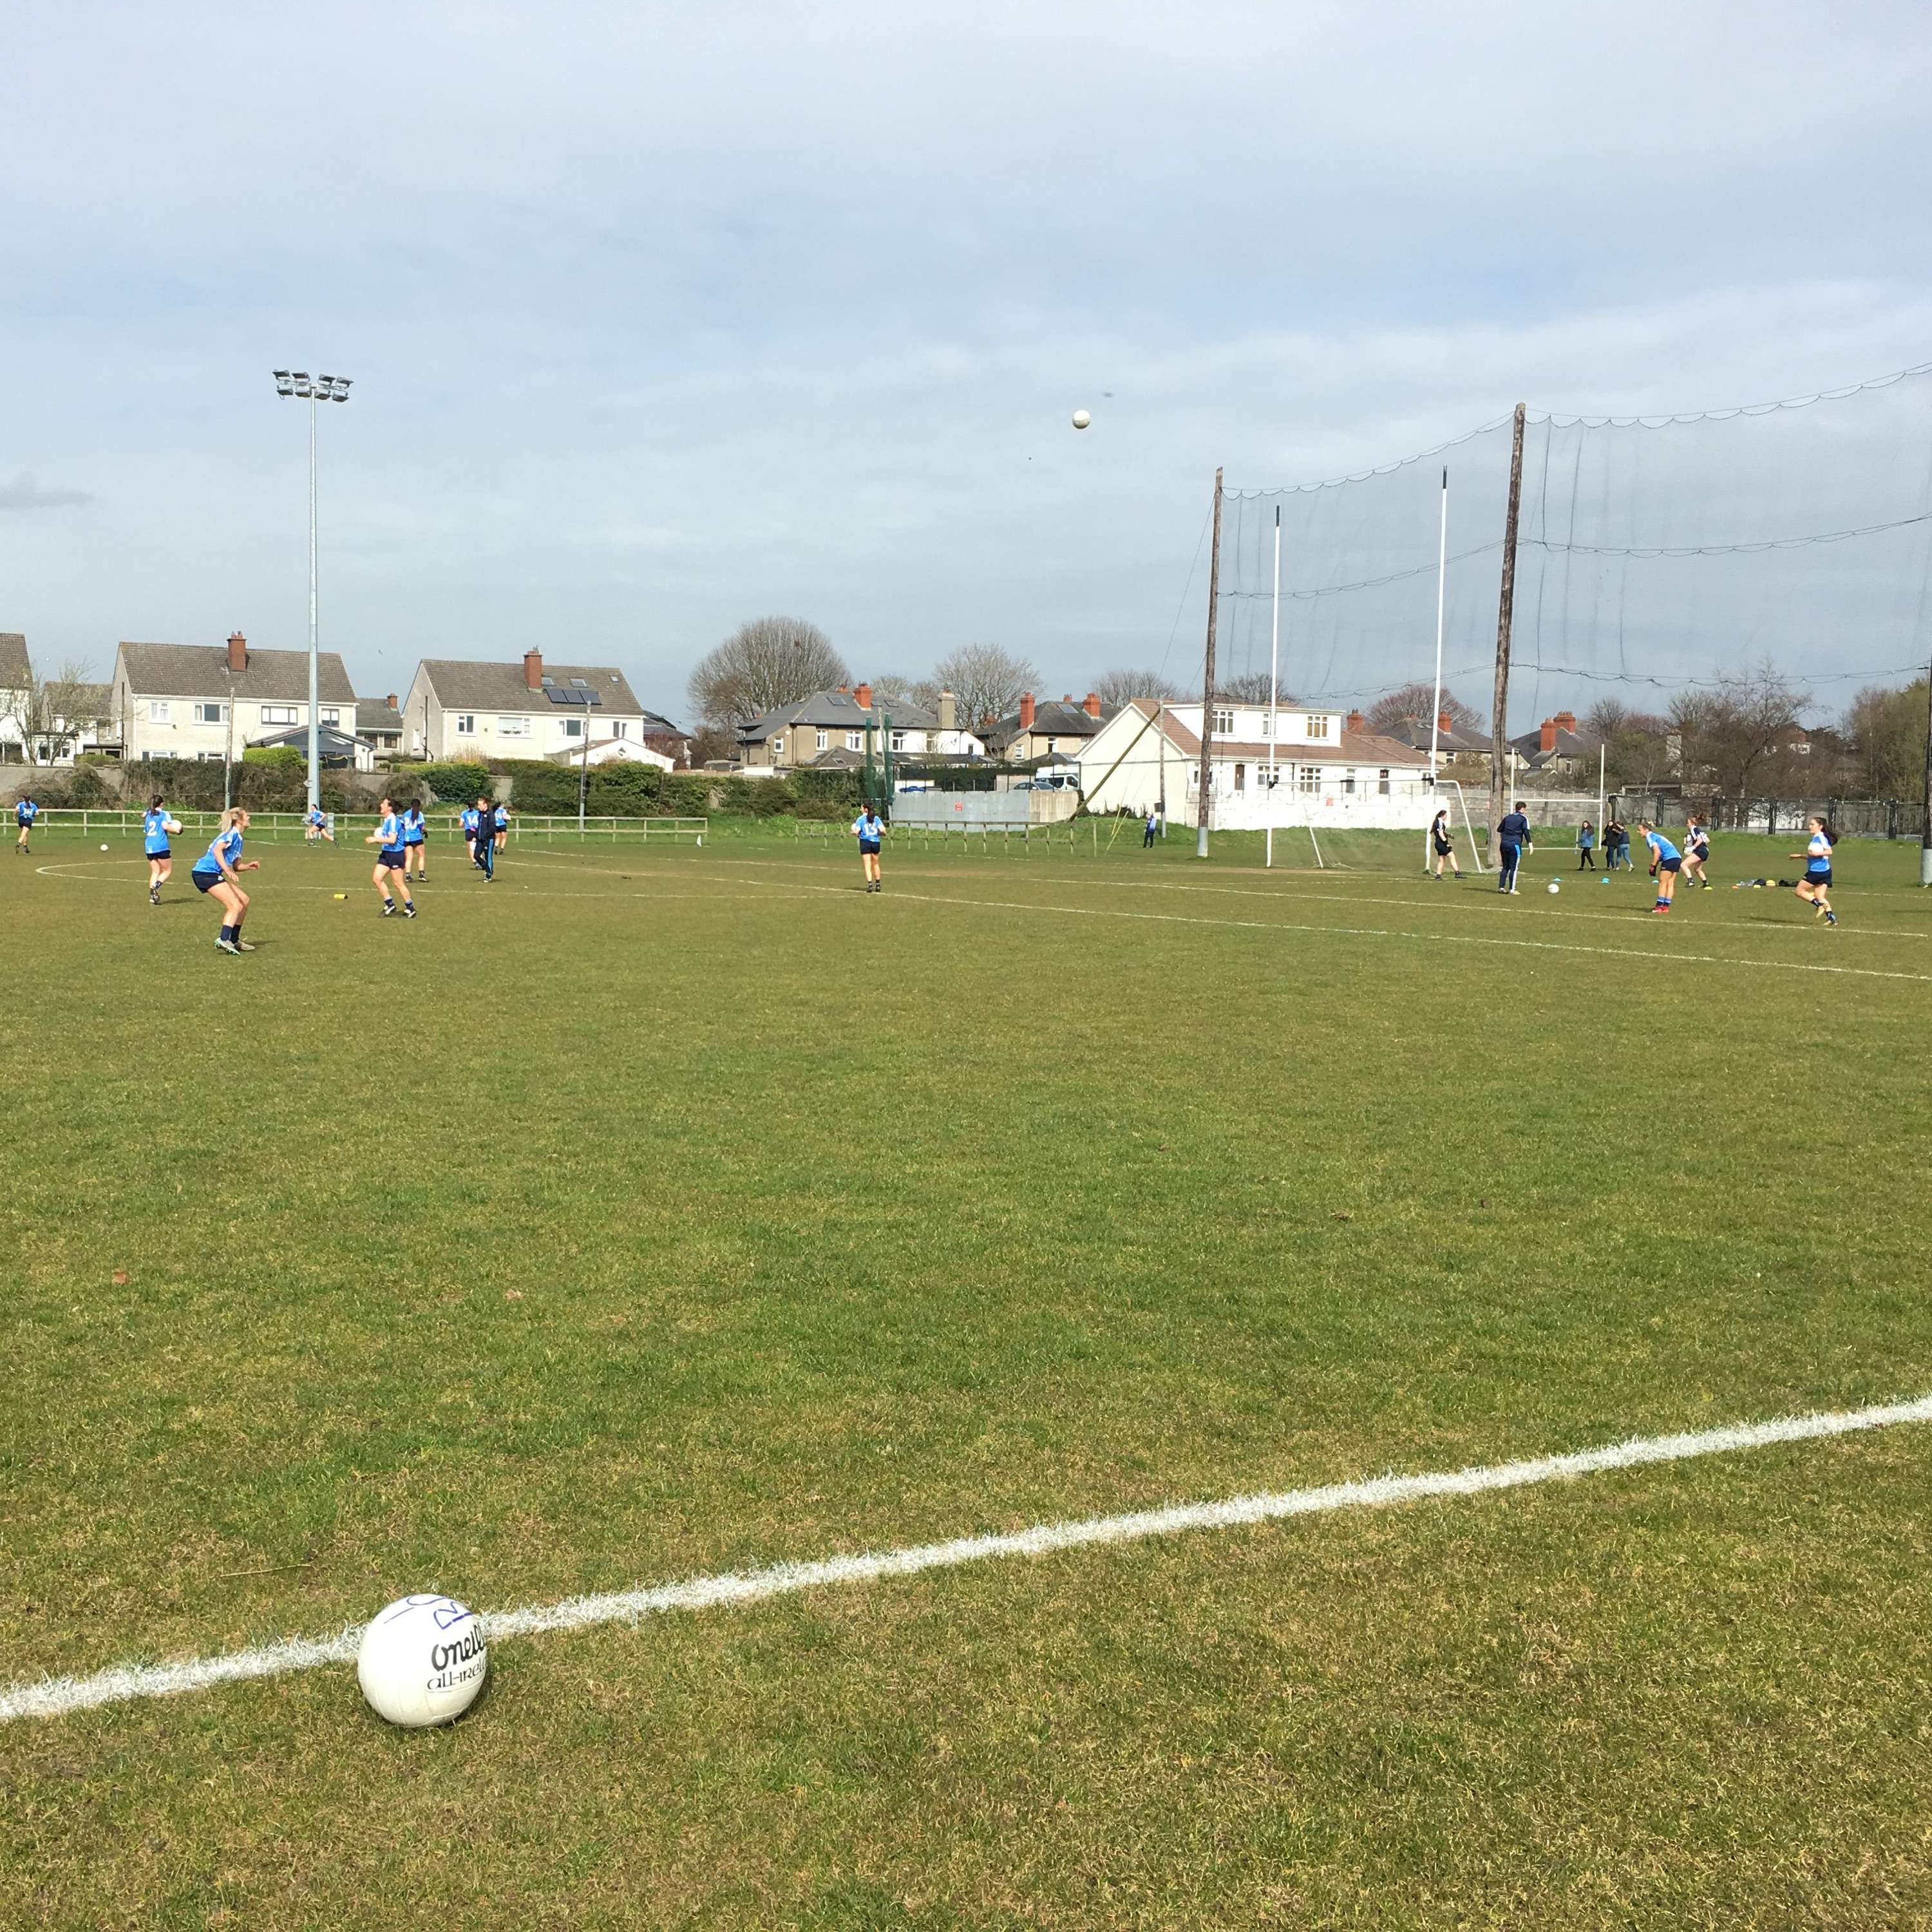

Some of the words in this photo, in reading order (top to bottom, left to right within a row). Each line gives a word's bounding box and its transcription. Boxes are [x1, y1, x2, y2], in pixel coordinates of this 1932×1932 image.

[466, 815, 478, 826] 14
[147, 820, 157, 837] 2
[864, 822, 878, 837] 13
